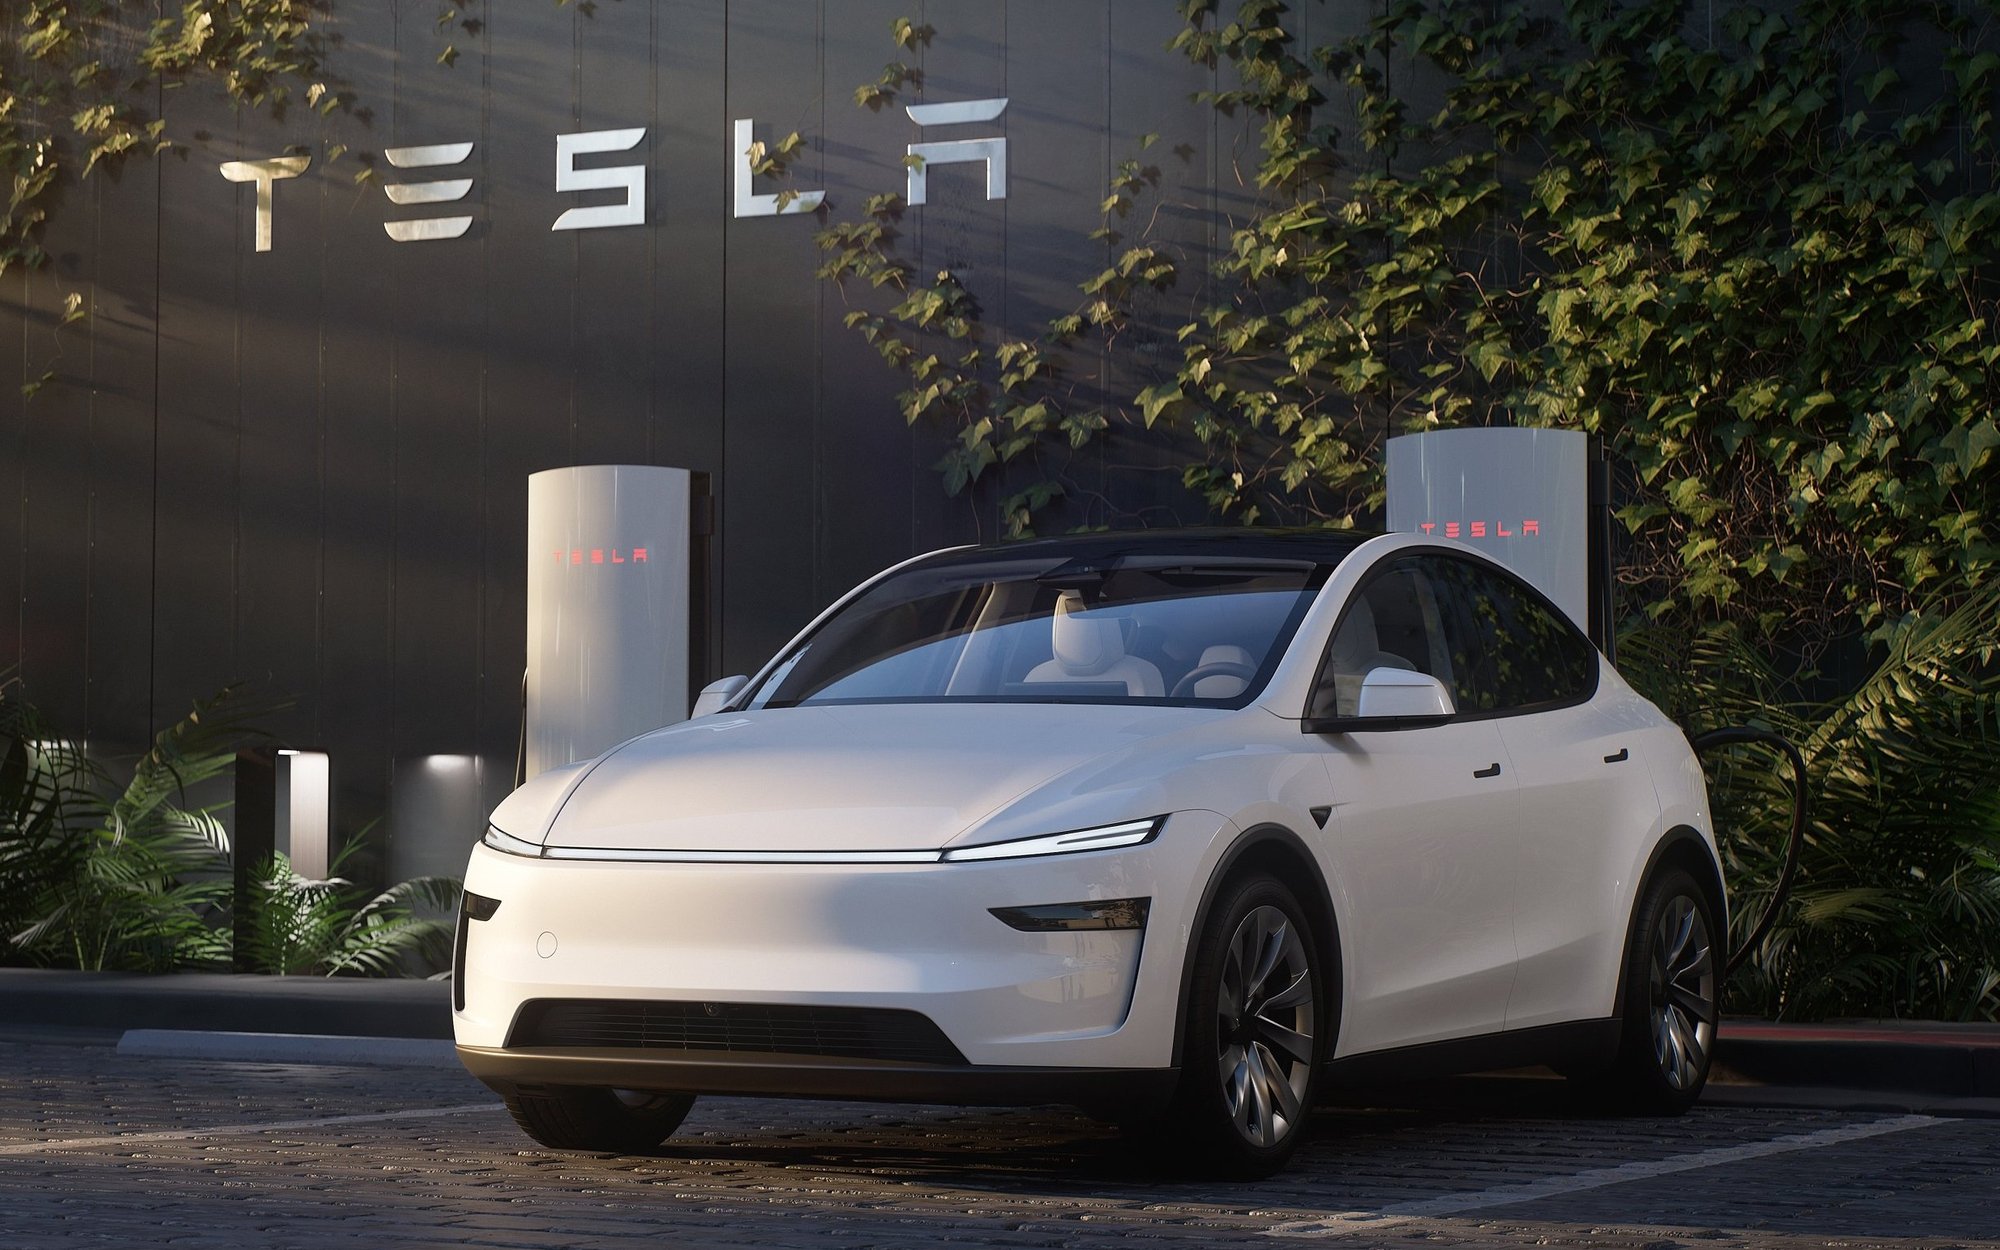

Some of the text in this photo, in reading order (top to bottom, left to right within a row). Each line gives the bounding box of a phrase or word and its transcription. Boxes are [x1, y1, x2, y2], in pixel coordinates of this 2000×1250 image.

[219, 97, 1009, 253] TESLA
[1420, 520, 1540, 538] TESLA
[552, 548, 648, 565] TESLA
